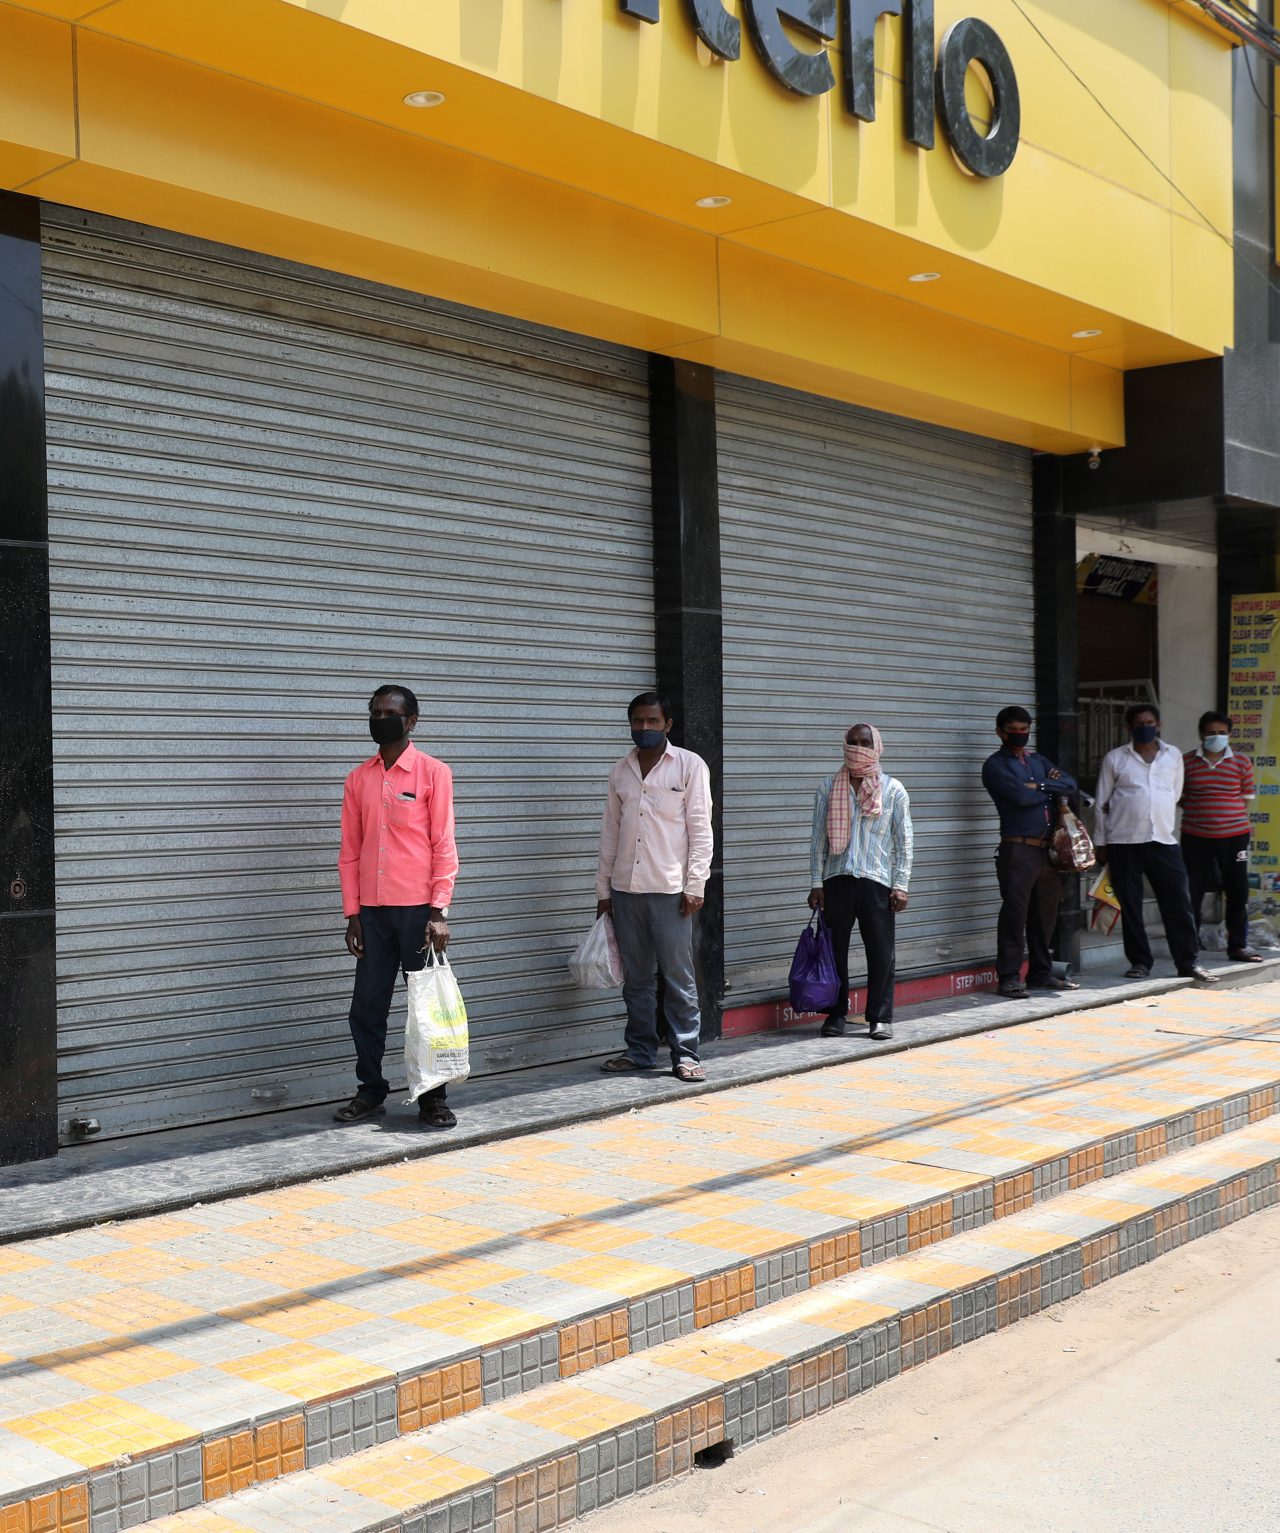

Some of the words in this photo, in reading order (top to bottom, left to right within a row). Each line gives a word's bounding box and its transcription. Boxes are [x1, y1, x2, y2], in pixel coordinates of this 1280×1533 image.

[620, 0, 1020, 178] erio
[1091, 557, 1153, 582] FURNITURE
[1233, 615, 1252, 625] TABLE
[1232, 629, 1251, 640] CLEAR
[1254, 629, 1272, 639] SHEET
[1232, 644, 1247, 654] SOFA
[1249, 643, 1270, 653] COVER
[1232, 657, 1259, 668] COASTER
[1231, 672, 1249, 682] TABLE
[1251, 671, 1277, 681] RUNNER
[1231, 685, 1257, 696] WASHING
[1243, 700, 1263, 710] COVER
[1243, 714, 1262, 724] SHEET
[1243, 728, 1263, 738] COVER
[1256, 756, 1277, 766] COVER
[1259, 784, 1279, 795] COVER
[1250, 813, 1270, 823] COVER
[956, 975, 974, 989] STEP
[976, 971, 993, 985] INTO
